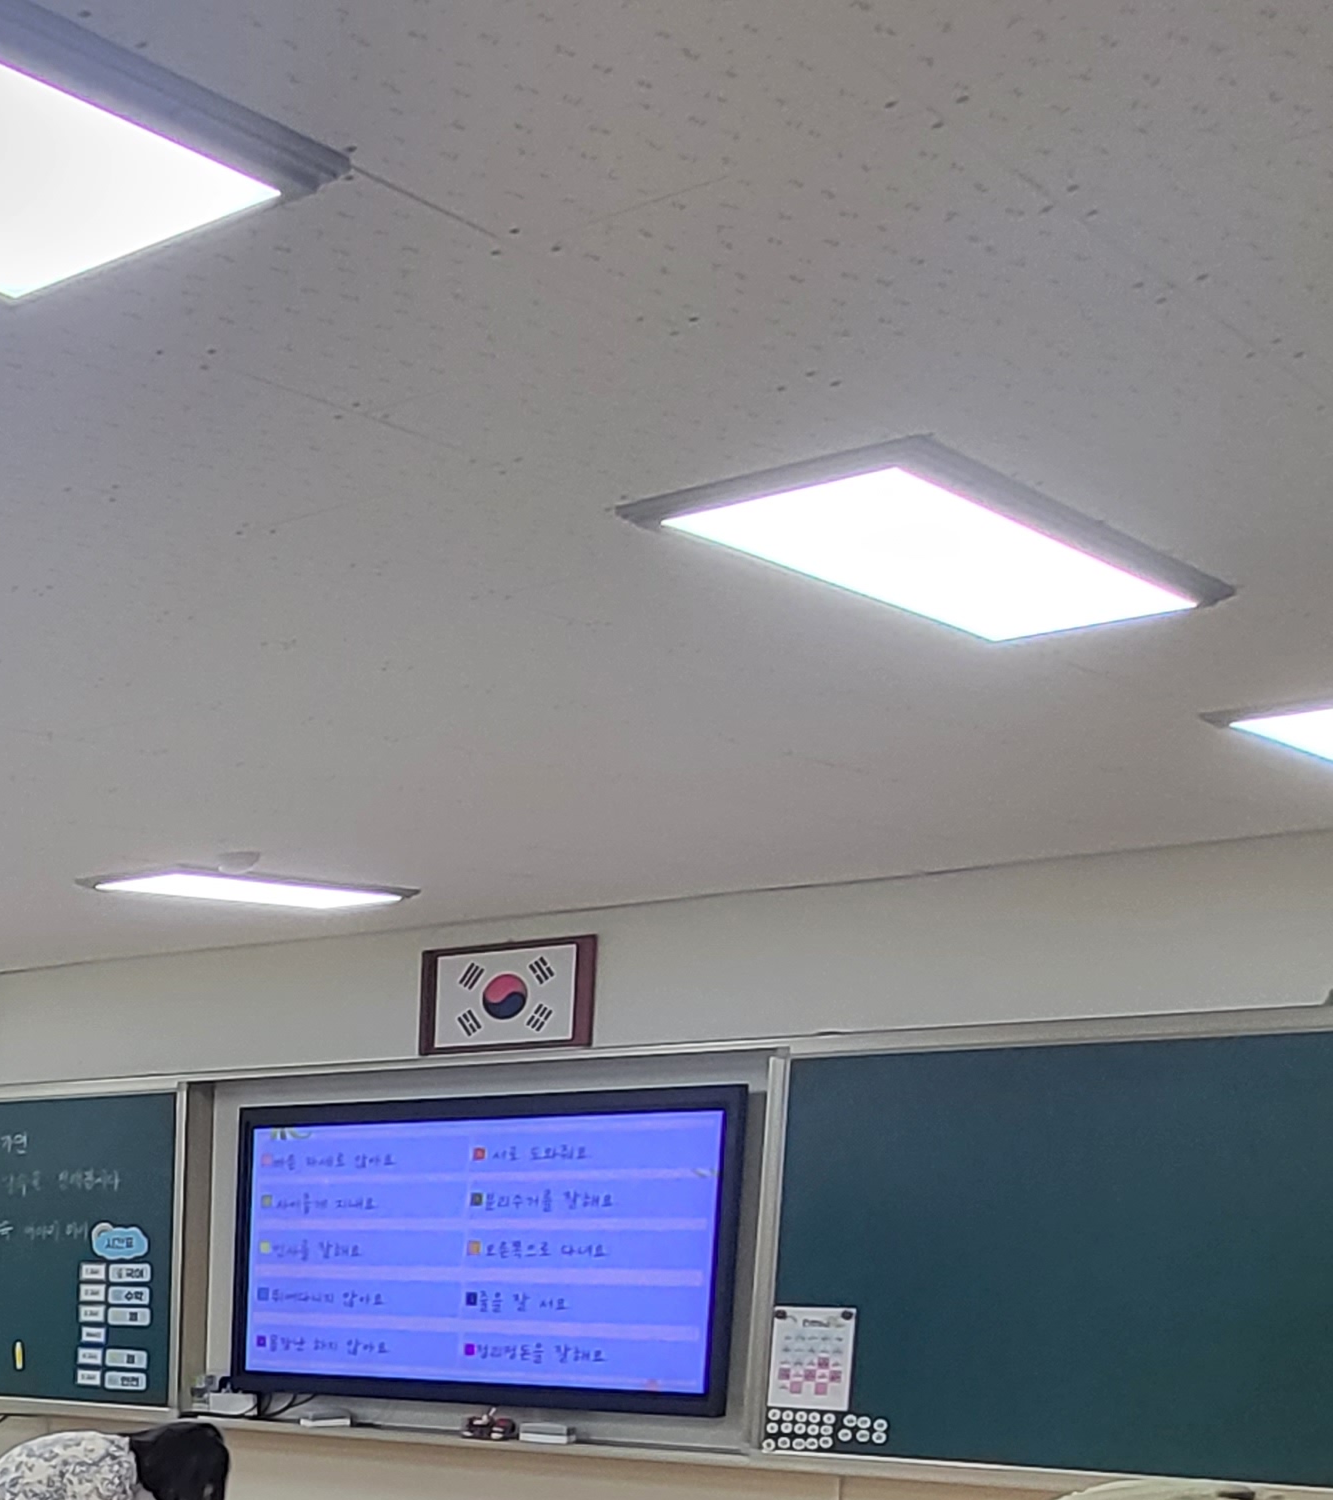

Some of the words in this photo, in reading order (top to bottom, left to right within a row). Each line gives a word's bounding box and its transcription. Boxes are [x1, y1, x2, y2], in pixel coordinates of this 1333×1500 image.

[492, 1146, 520, 1161] 서로
[485, 1188, 553, 1213] 분리수거를
[563, 1190, 617, 1210] 잘해요
[553, 1344, 609, 1364] 잘해요
